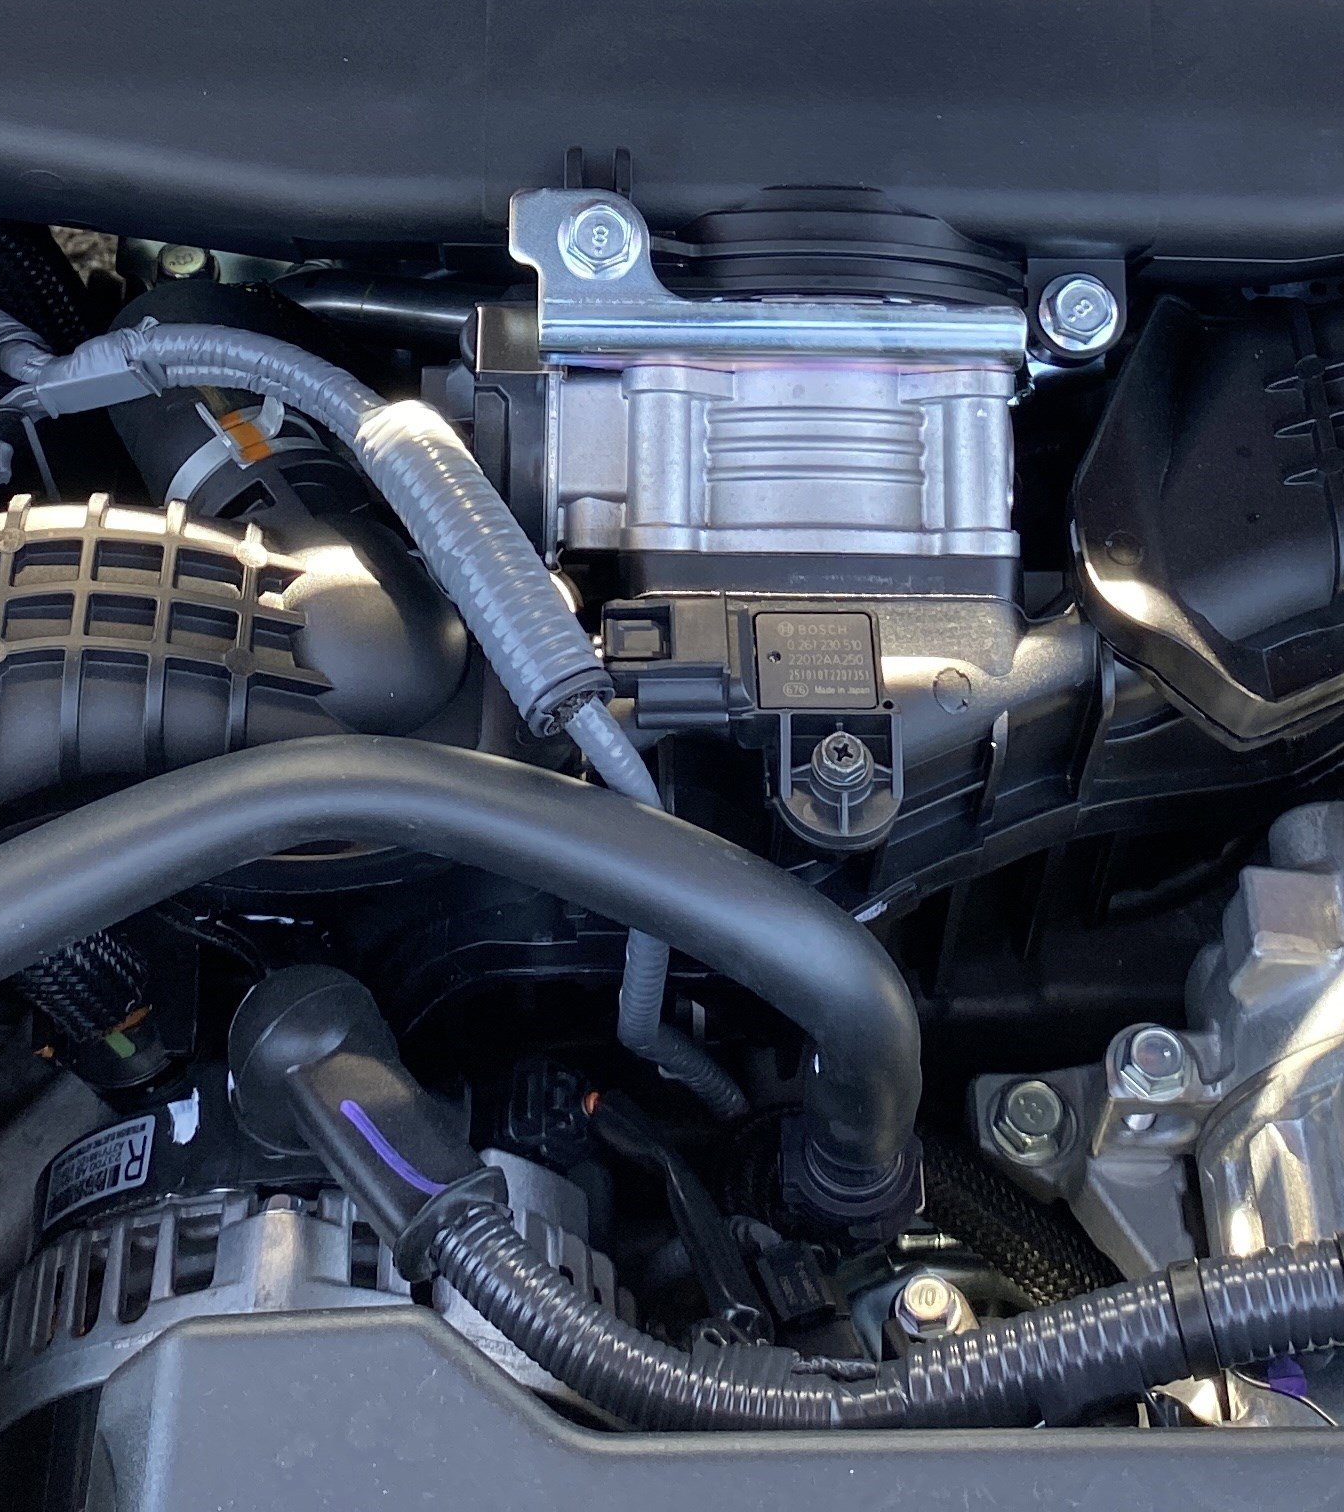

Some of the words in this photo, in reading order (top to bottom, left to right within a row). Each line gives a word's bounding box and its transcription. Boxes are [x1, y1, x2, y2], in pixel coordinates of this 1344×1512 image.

[592, 225, 609, 246] 8
[1073, 299, 1094, 318] 8
[798, 625, 847, 635] BOSCH
[787, 641, 794, 651] 0
[798, 640, 816, 651] 261
[821, 640, 840, 651] 230
[843, 640, 862, 651] 510
[788, 654, 864, 666] 22012AA250
[786, 685, 806, 694] 676
[814, 685, 835, 694] Made
[837, 685, 845, 694] in
[847, 686, 870, 696] Japan
[125, 1135, 148, 1180] R
[917, 1285, 937, 1307] 10
